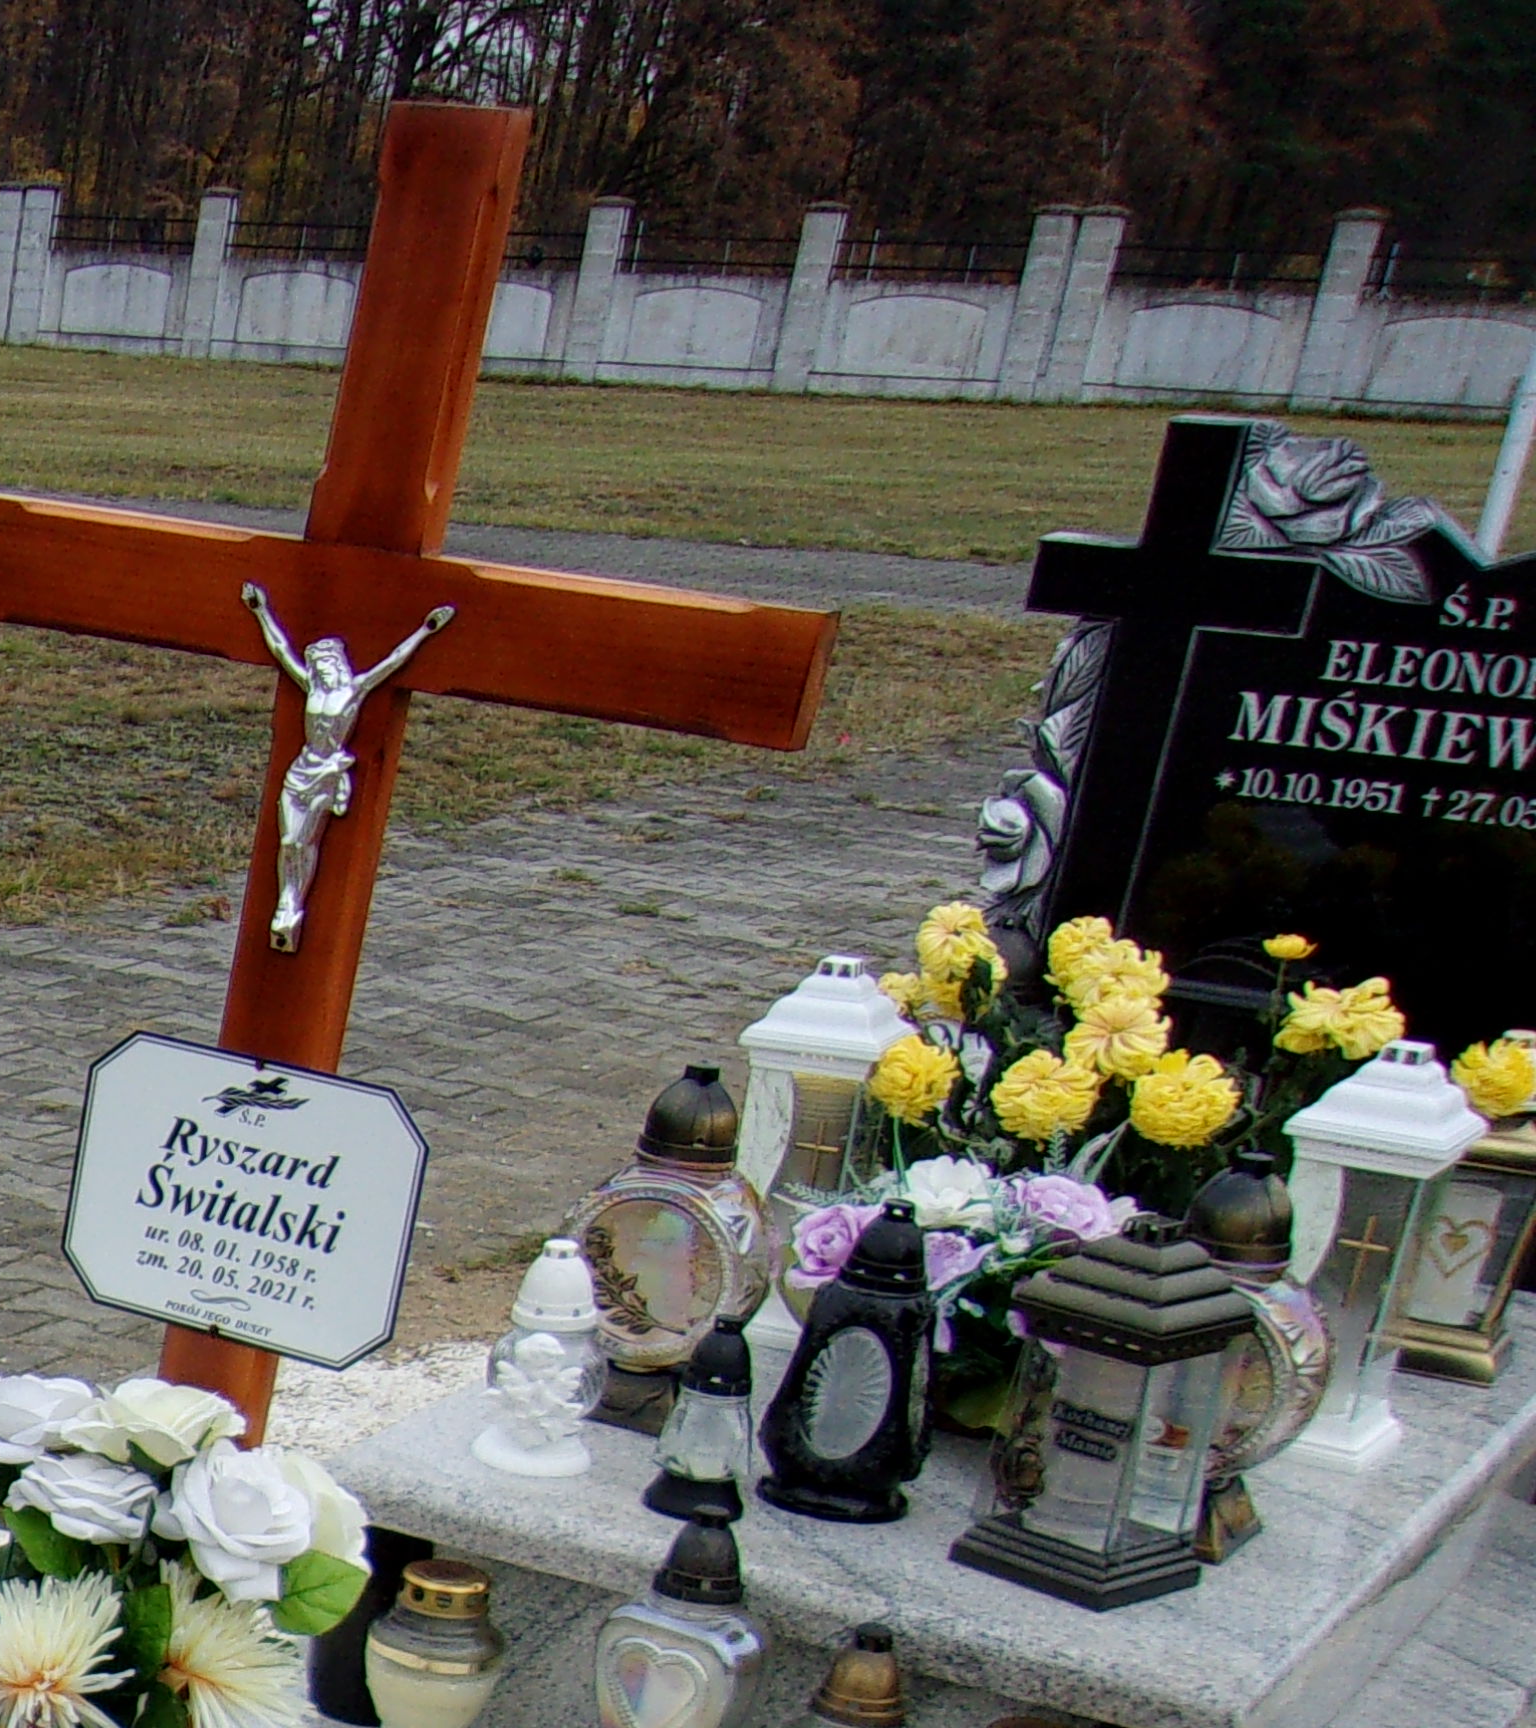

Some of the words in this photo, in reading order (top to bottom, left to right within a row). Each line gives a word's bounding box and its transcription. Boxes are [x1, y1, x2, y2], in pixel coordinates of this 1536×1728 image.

[1439, 582, 1516, 630] Ś.P.
[159, 1116, 341, 1189] Ryszard
[135, 1152, 347, 1254] Świtalski
[136, 1249, 168, 1270] zm.
[176, 1256, 204, 1280] 20.
[212, 1266, 240, 1290] 05.
[247, 1275, 298, 1304] 2021
[301, 1295, 315, 1310] r.
[144, 1225, 170, 1243] ur.
[178, 1229, 205, 1253] 08.
[213, 1239, 241, 1263] 01.
[248, 1248, 300, 1277] 1958
[303, 1268, 317, 1283] r.
[165, 1299, 201, 1317] POKÓJ
[201, 1310, 231, 1325] JEGO
[234, 1320, 272, 1337] DUSZY
